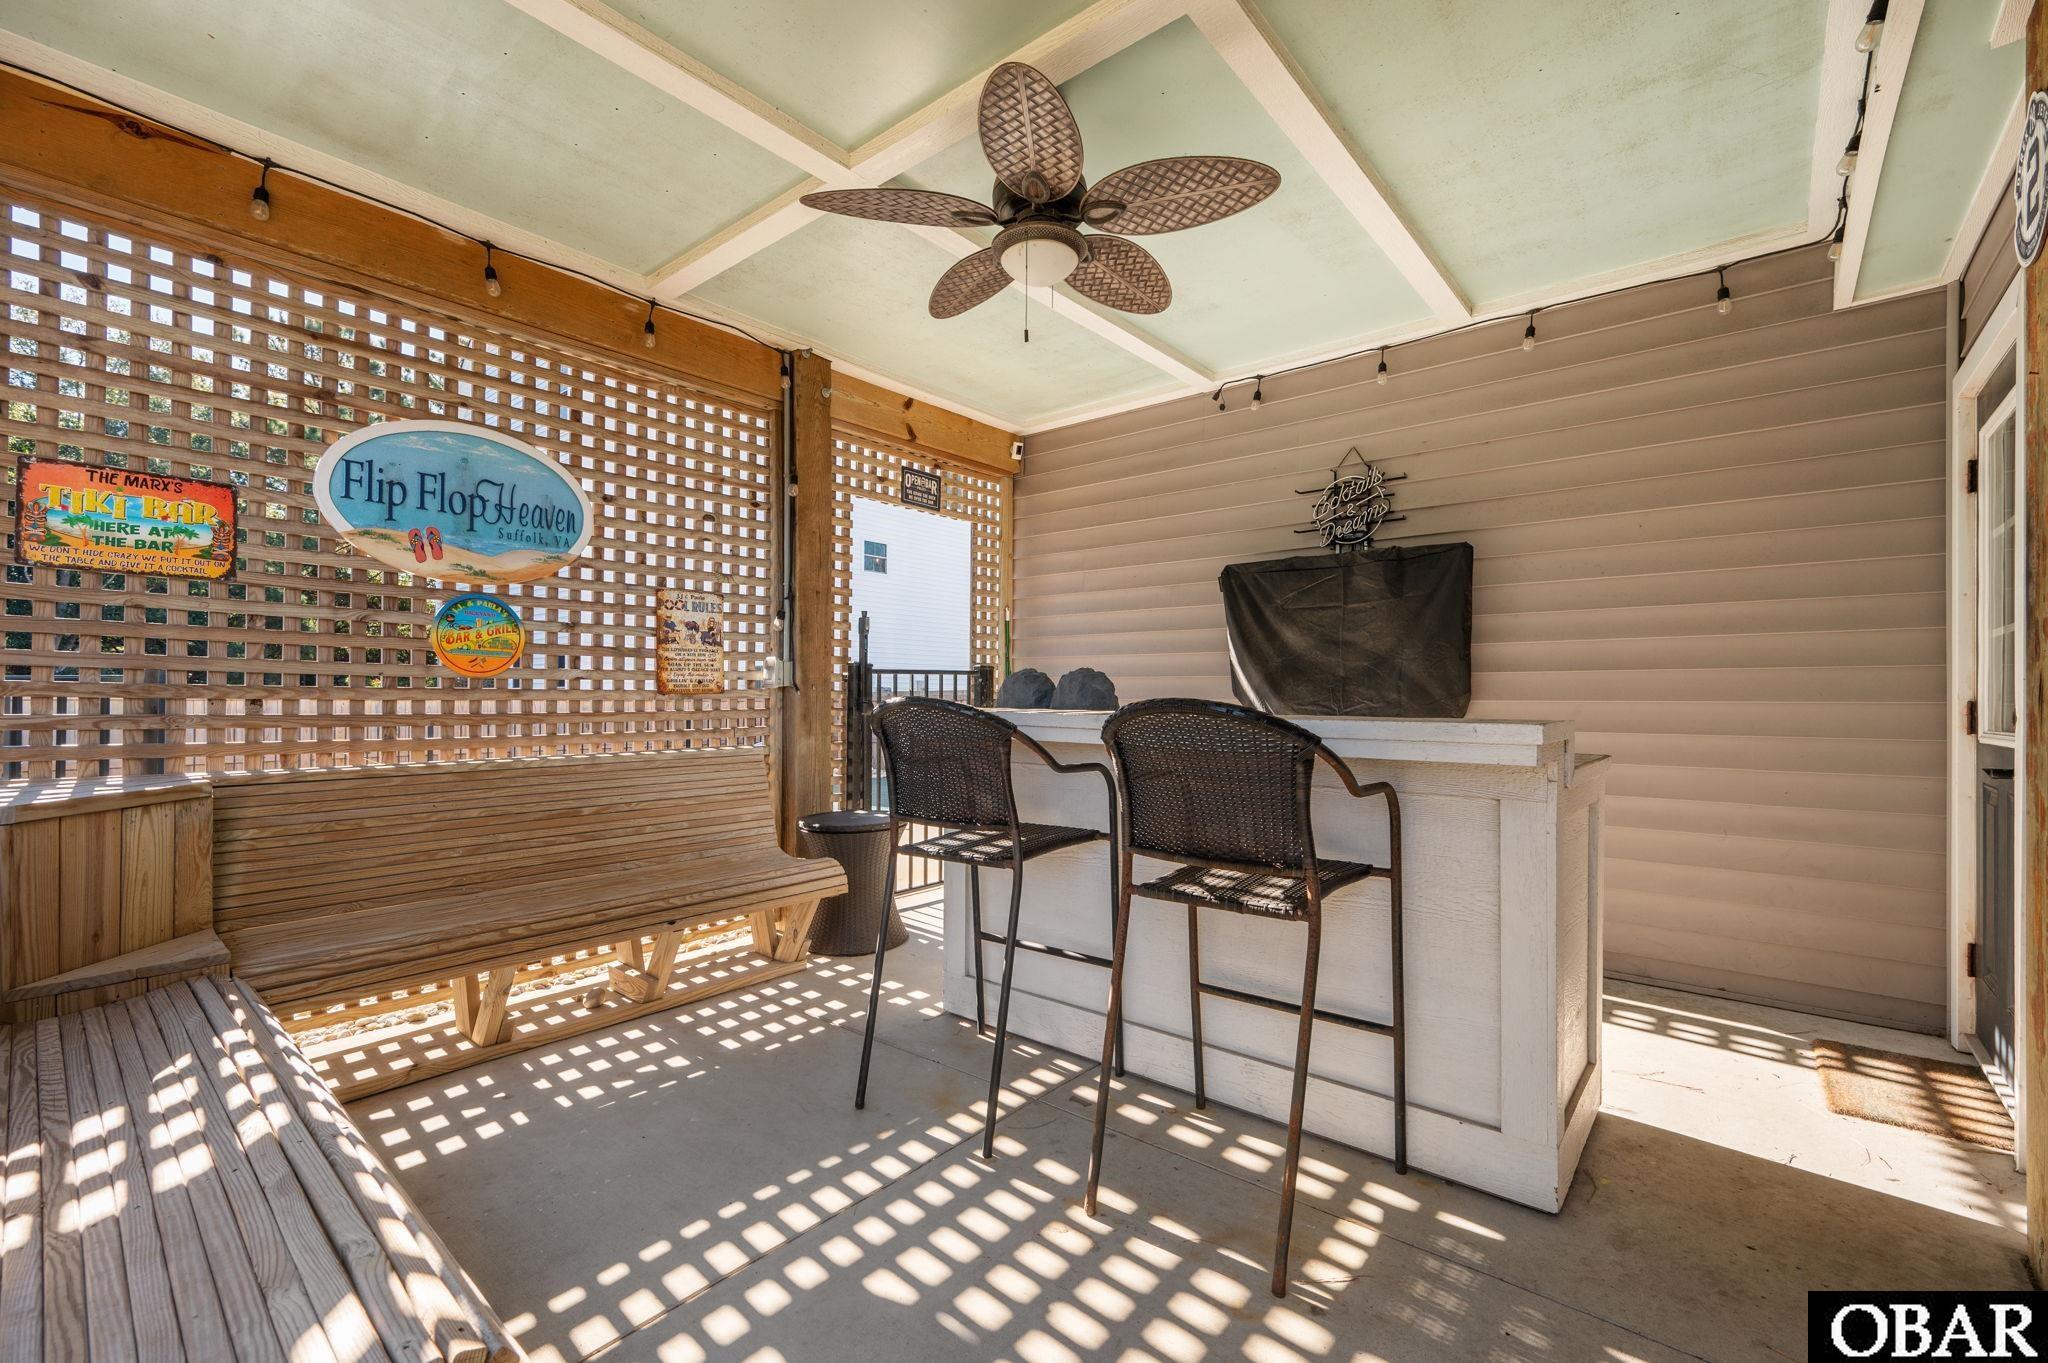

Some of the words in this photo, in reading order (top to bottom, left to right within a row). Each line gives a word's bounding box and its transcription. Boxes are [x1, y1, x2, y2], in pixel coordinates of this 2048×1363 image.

[86, 469, 119, 485] THE
[124, 472, 183, 494] MARX'S
[39, 483, 128, 520] TIKI
[141, 495, 219, 527] BAR
[340, 457, 407, 522] Flip
[416, 471, 488, 533] Flop
[476, 478, 577, 534] Heaven
[1346, 503, 1356, 516] &
[92, 520, 141, 536] HERE
[148, 526, 171, 539] AT
[1320, 502, 1388, 547] Dreams
[92, 535, 127, 548] THE
[134, 538, 174, 554] BAR
[498, 527, 549, 547] Suffolk,
[555, 535, 570, 548] VA
[29, 544, 46, 553] WE
[82, 548, 104, 558] HIDE
[107, 551, 139, 561] CRAZY
[141, 554, 157, 562] WE
[160, 556, 178, 564] PUT
[194, 559, 211, 567] OUT
[41, 553, 61, 563] THE
[65, 555, 95, 565] TABLE
[98, 558, 117, 567] AND
[119, 560, 141, 568] GIVE
[144, 562, 154, 570] IT
[165, 564, 208, 575] COCKTAIL
[691, 601, 722, 614] RULES
[445, 629, 470, 645] BAR
[475, 629, 483, 639] &
[486, 623, 517, 637] GRILL
